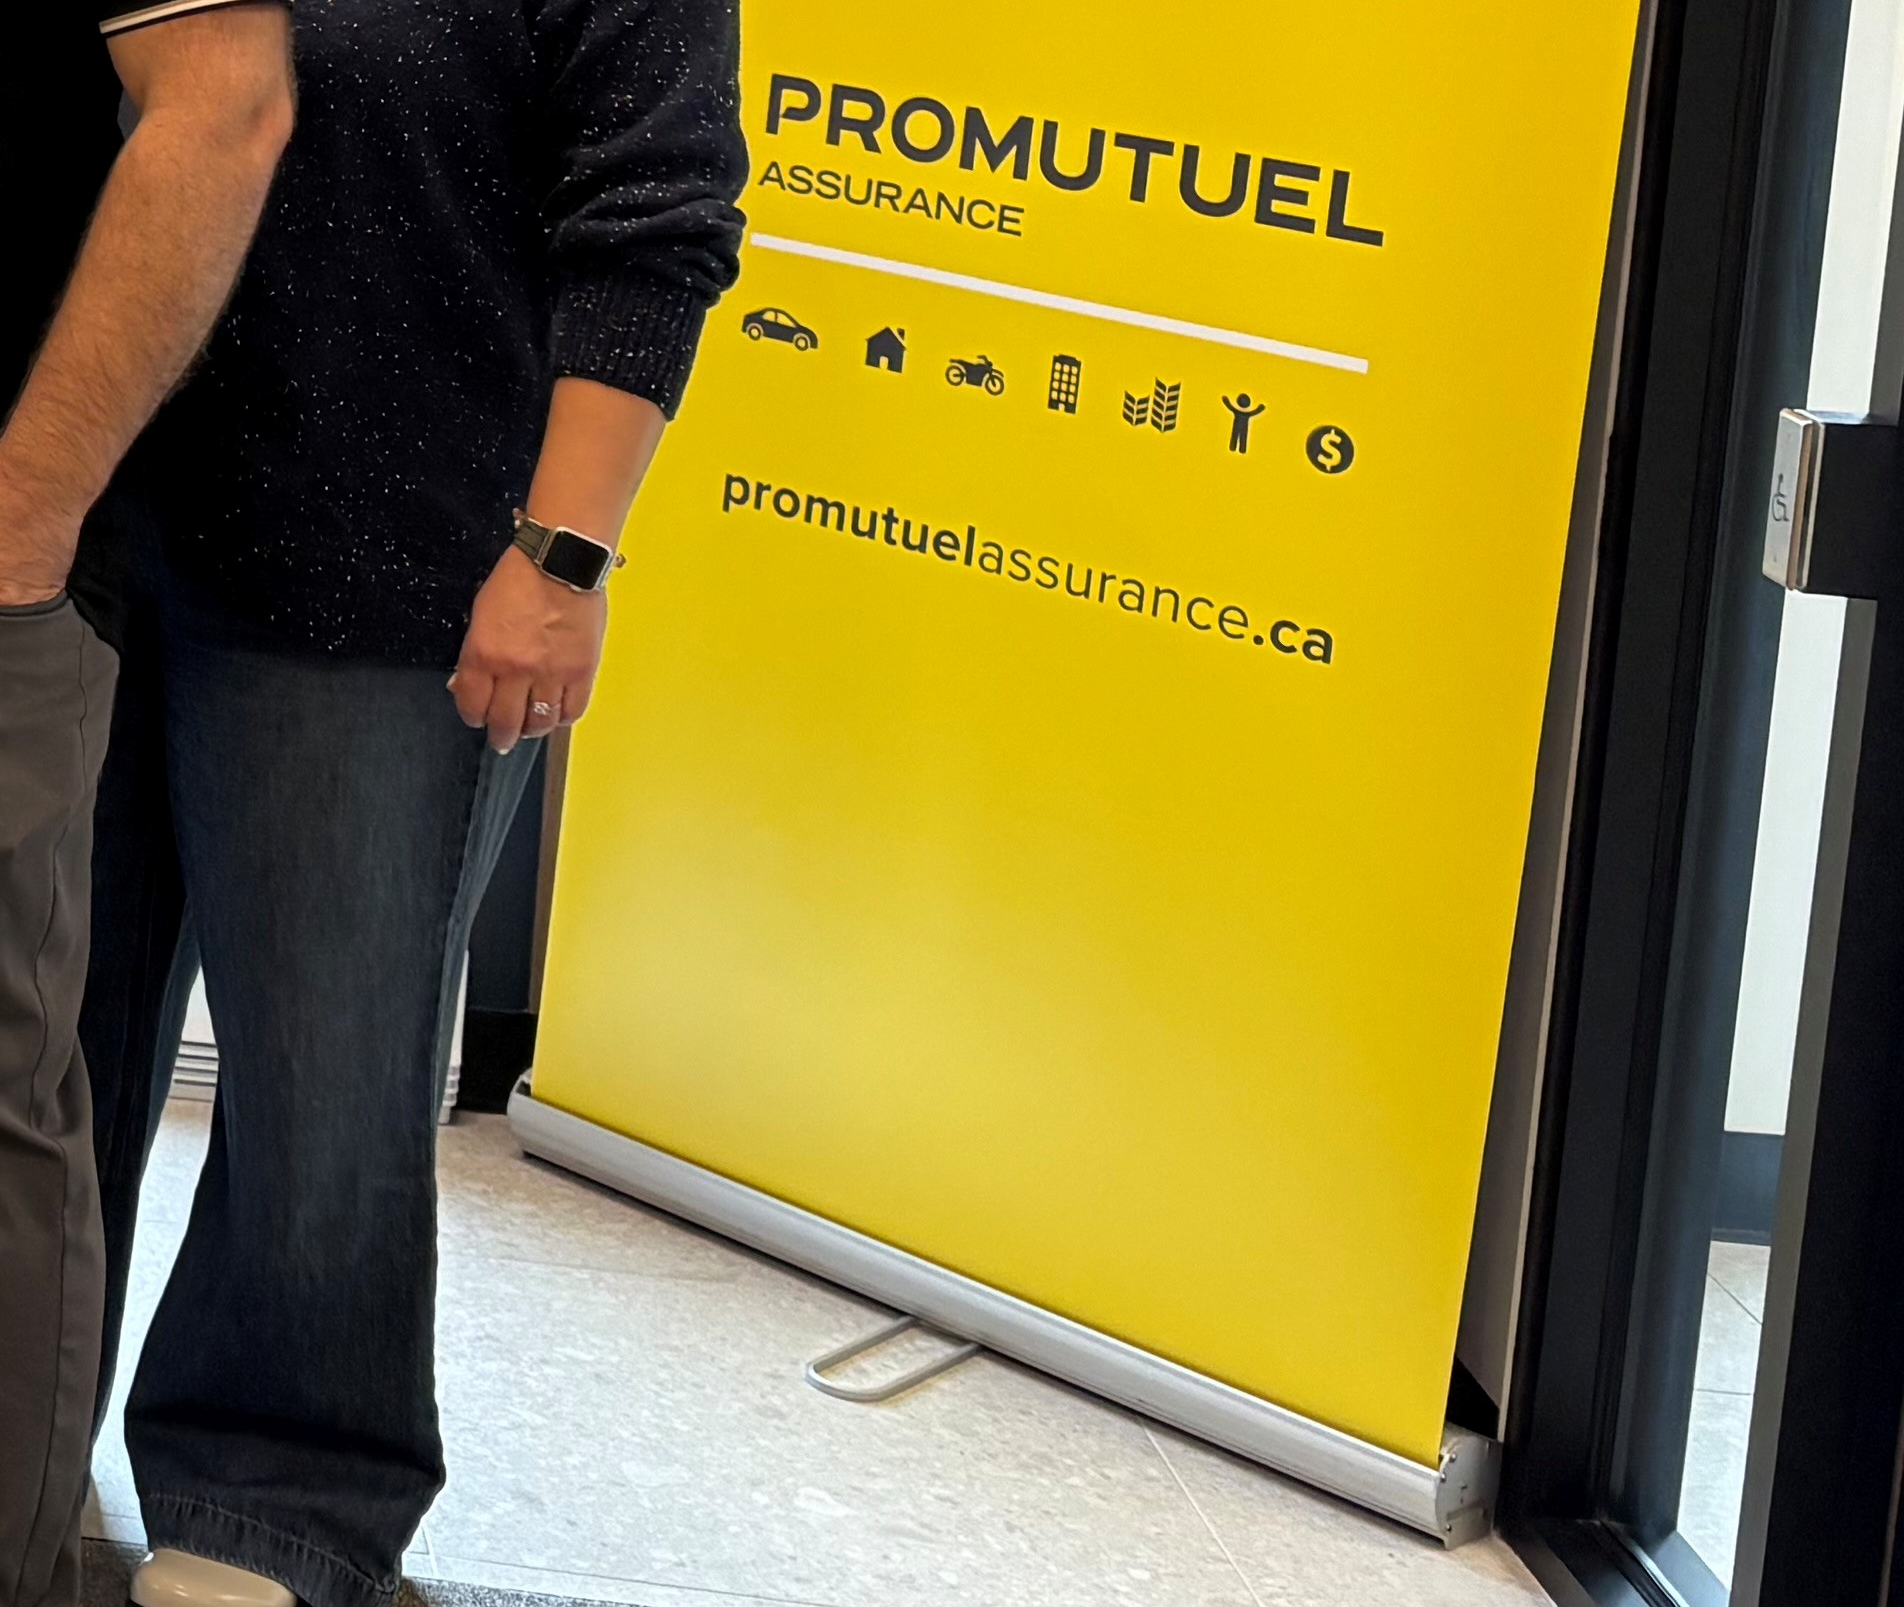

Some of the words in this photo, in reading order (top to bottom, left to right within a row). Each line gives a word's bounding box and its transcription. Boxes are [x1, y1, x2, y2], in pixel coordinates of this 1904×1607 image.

[758, 161, 1025, 237] ASSURANCE
[766, 73, 1385, 248] PROMUTUEL
[722, 472, 1333, 665] promutuelassurance.ca
